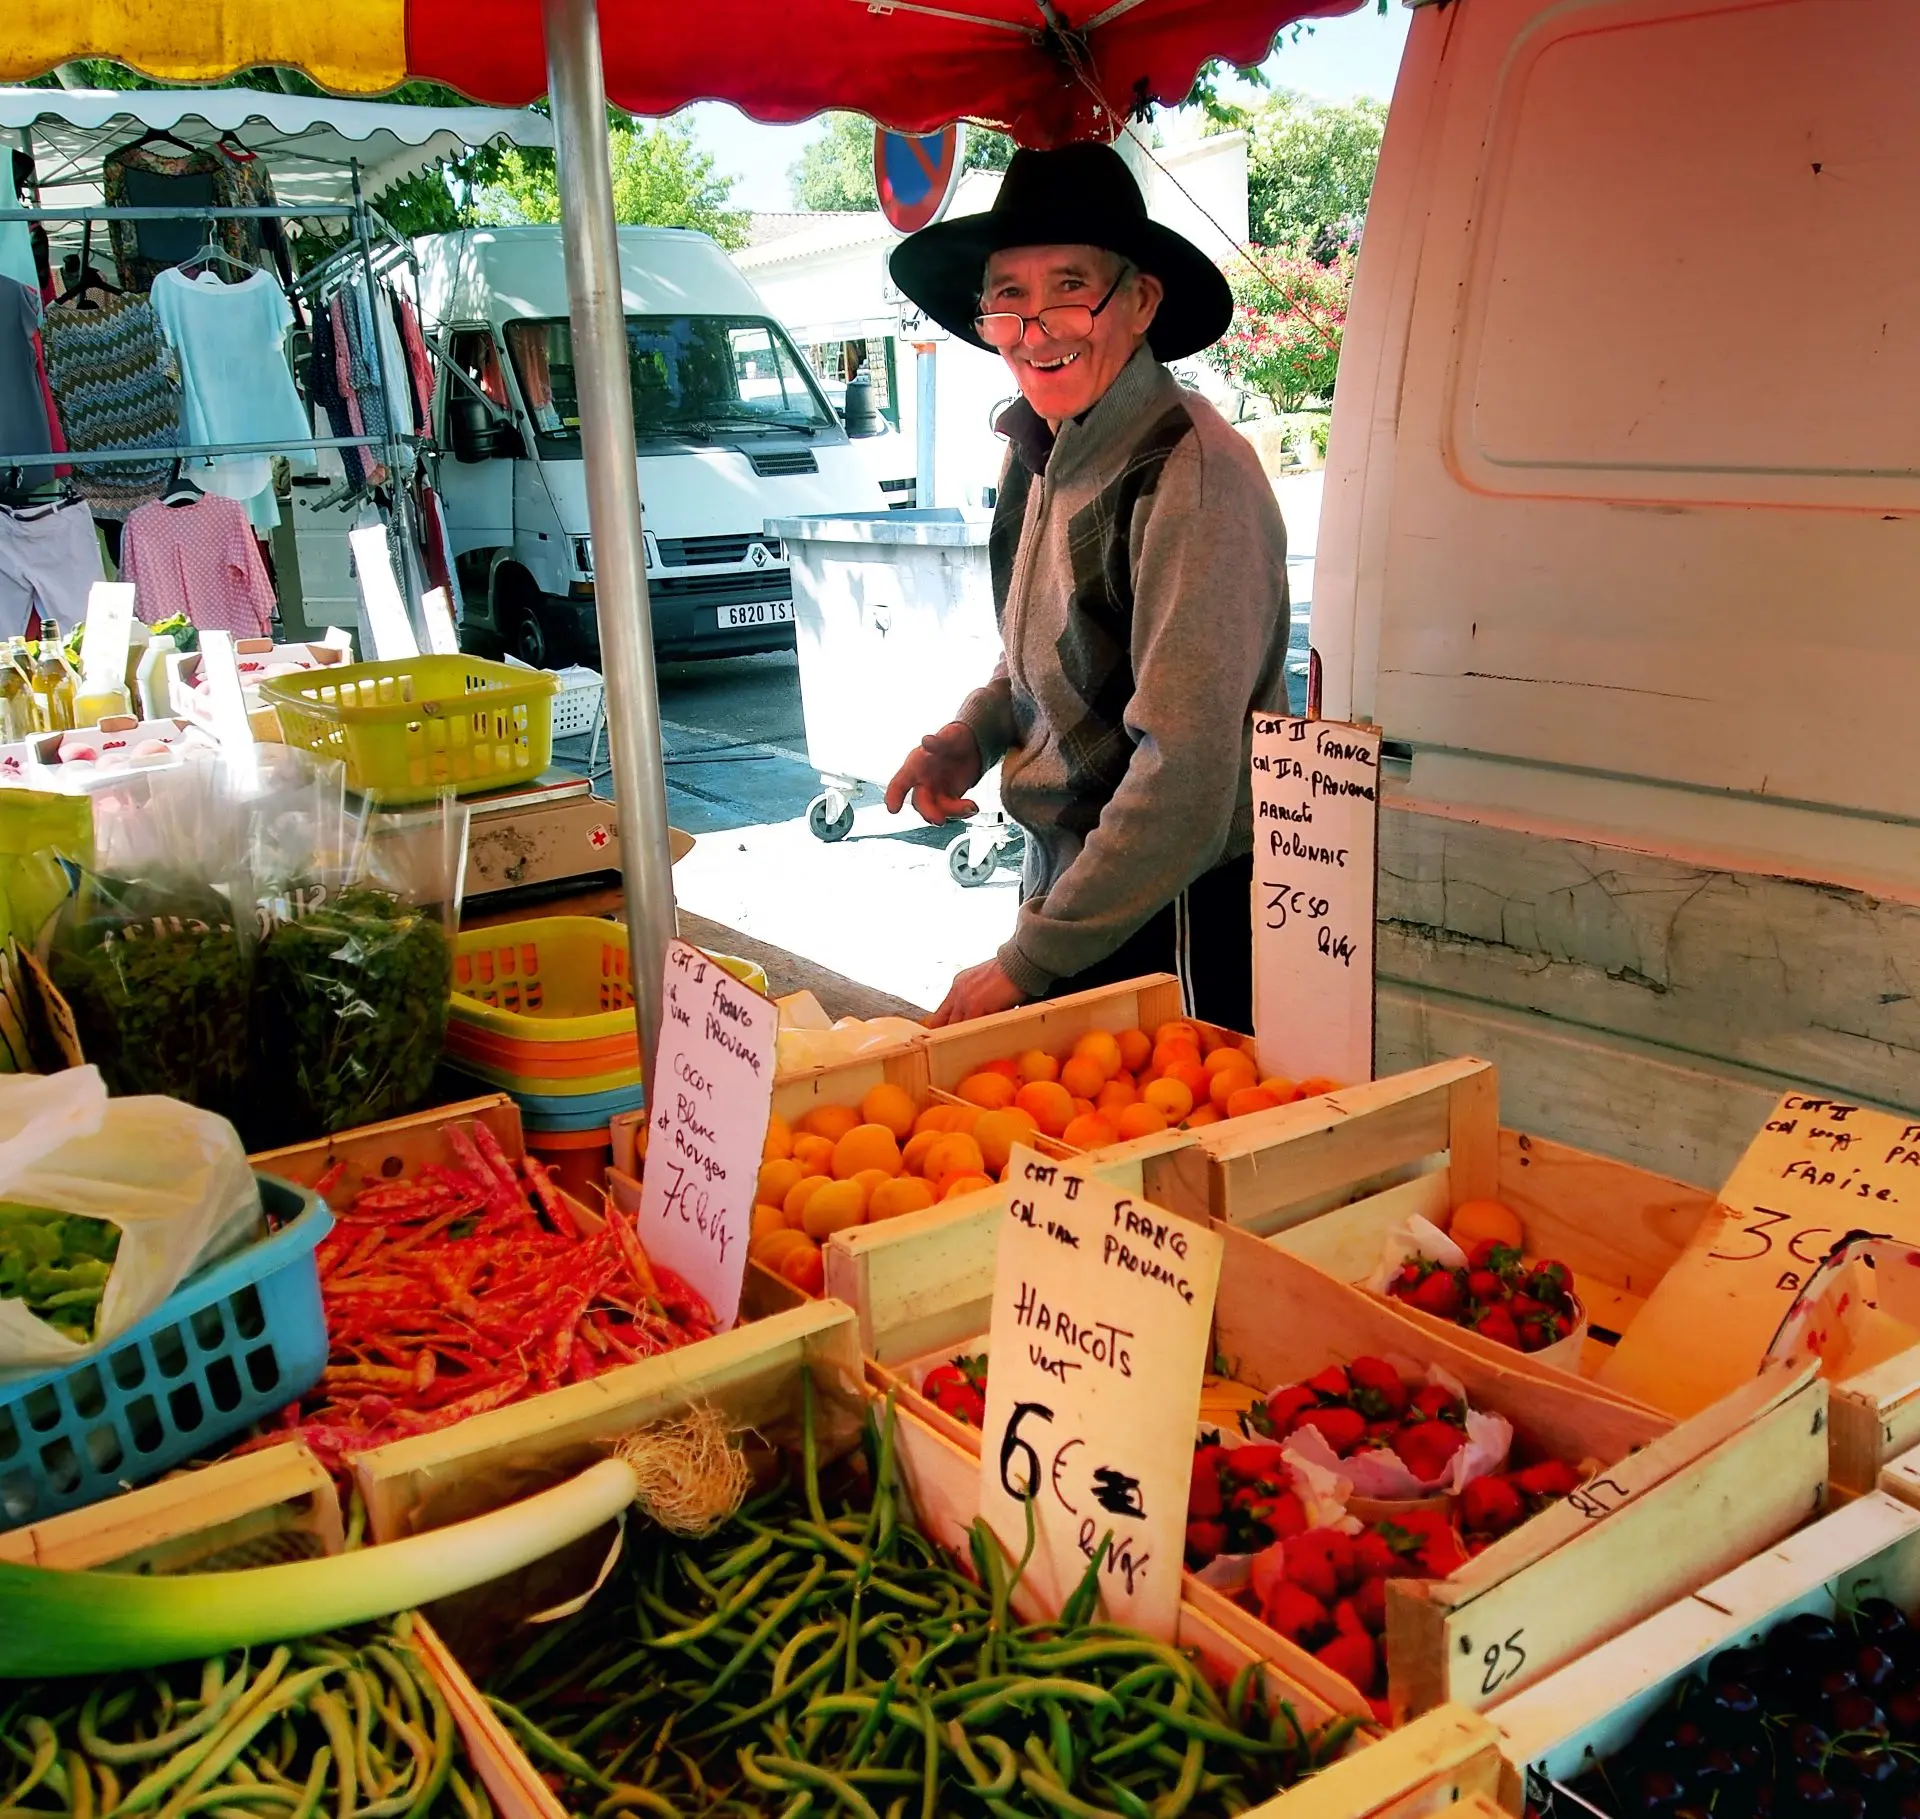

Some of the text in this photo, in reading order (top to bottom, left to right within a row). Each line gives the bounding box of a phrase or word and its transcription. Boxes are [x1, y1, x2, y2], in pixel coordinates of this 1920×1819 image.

[729, 605, 764, 624] 6820
[770, 603, 785, 620] TS
[1289, 719, 1315, 741] II
[1828, 1105, 1859, 1121] II
[1024, 1162, 1058, 1187] CAT
[1063, 1176, 1084, 1200] II
[1013, 1282, 1135, 1377] HARICOTS
